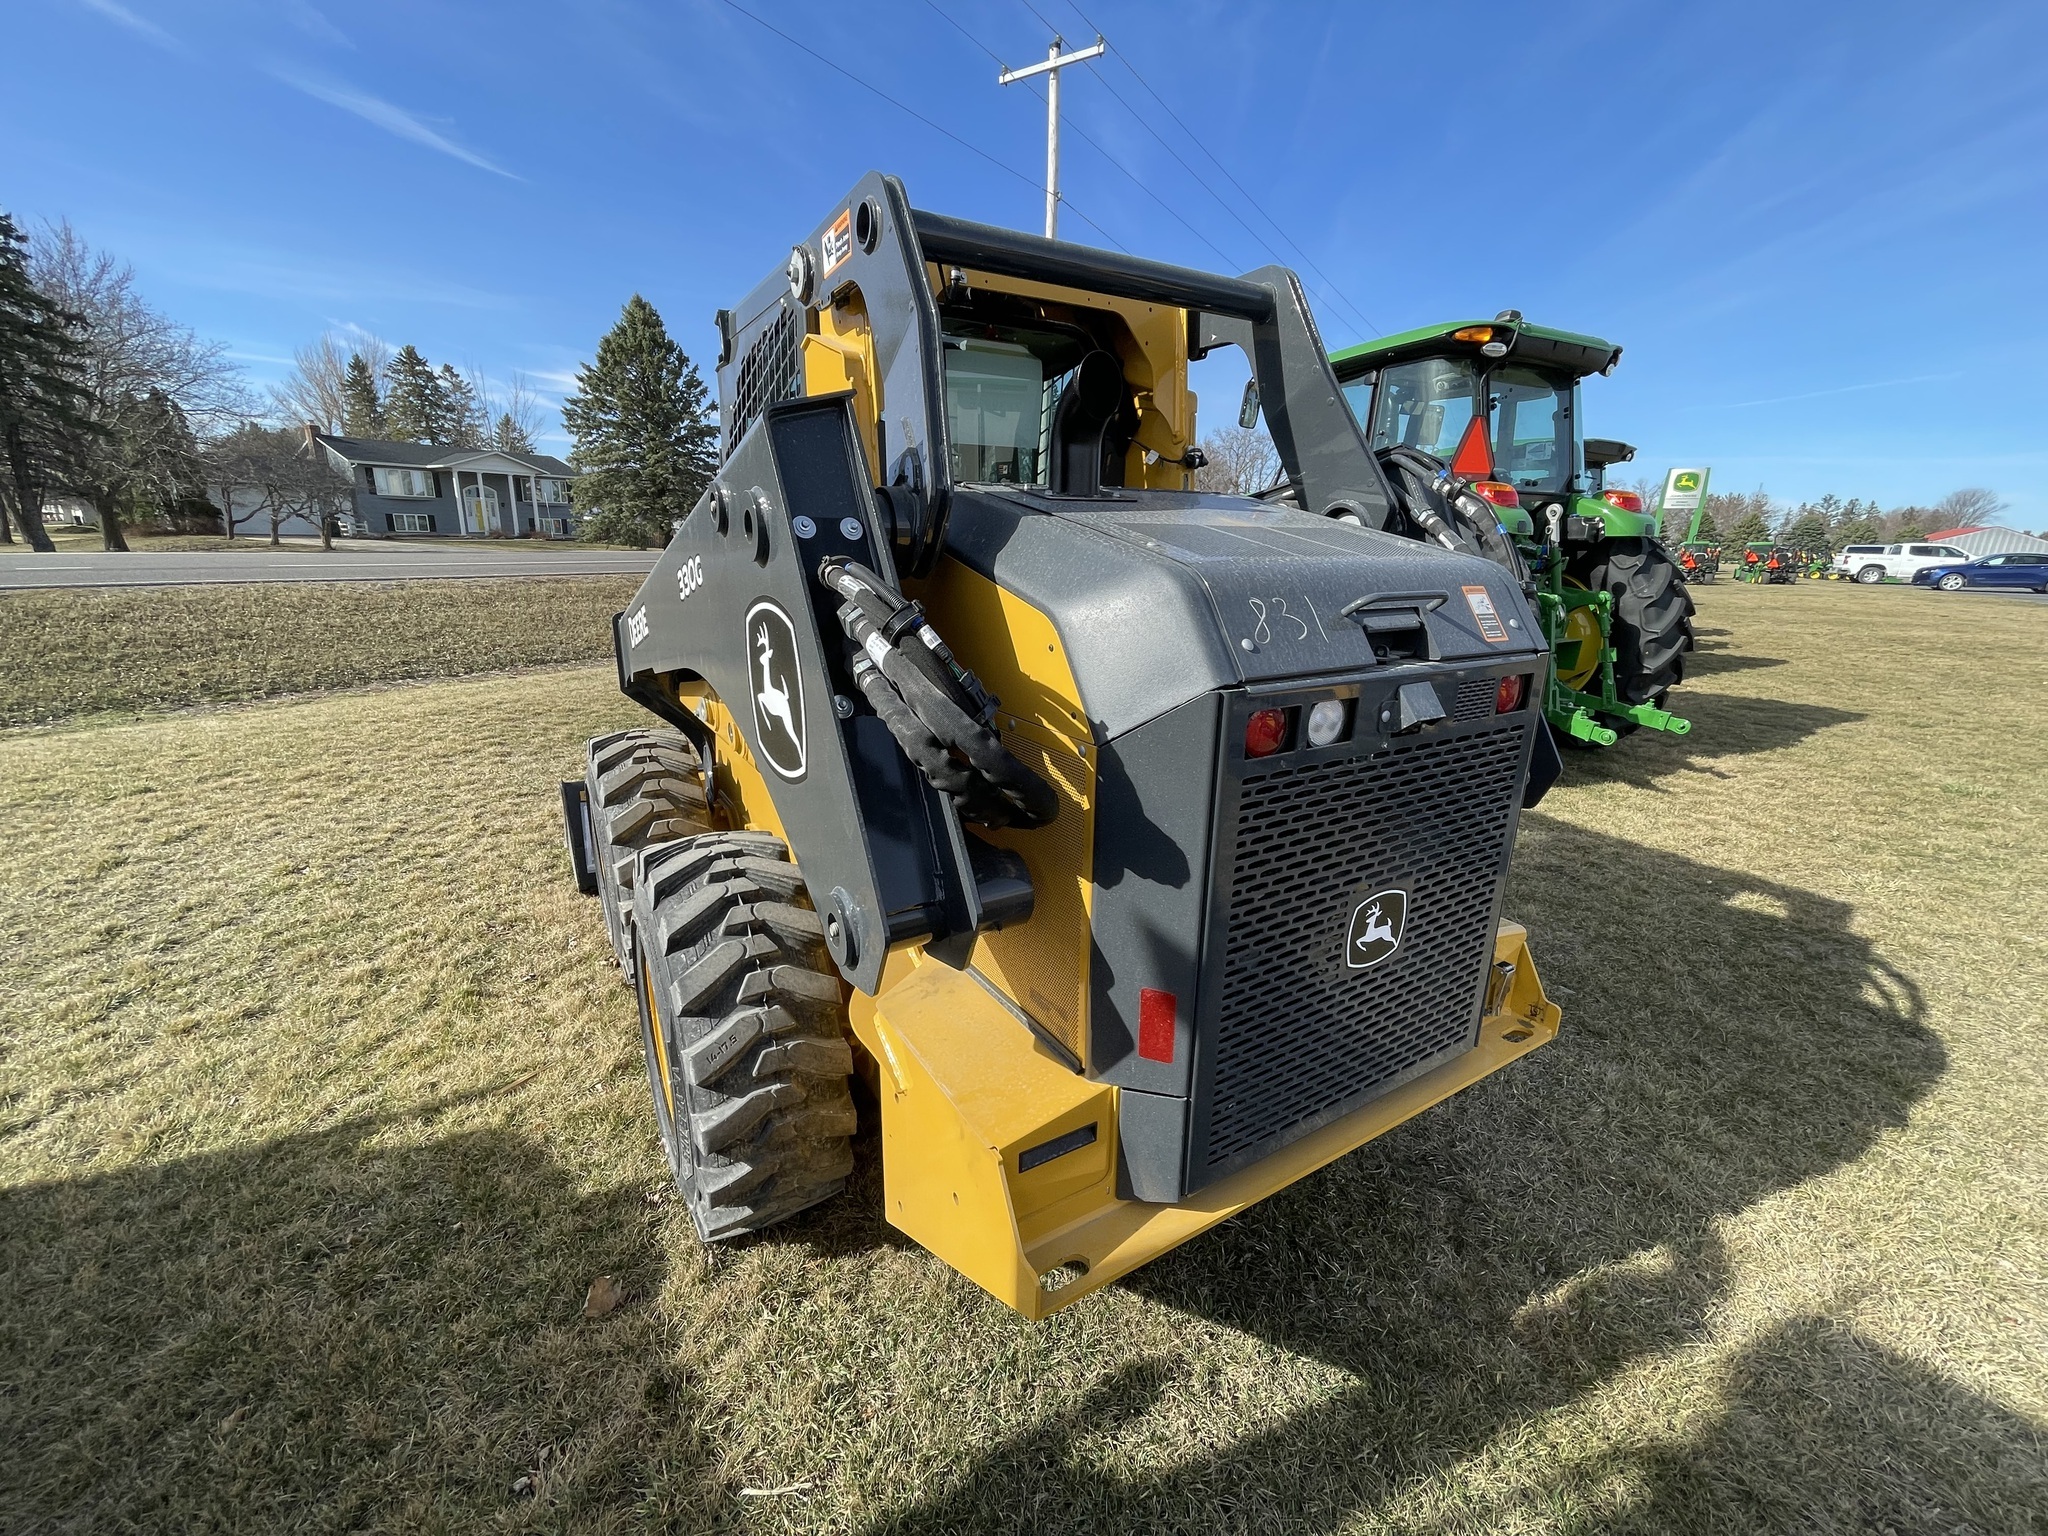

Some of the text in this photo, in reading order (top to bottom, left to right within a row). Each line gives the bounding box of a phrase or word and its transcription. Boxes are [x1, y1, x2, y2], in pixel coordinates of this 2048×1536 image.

[677, 555, 703, 600] 330G
[628, 605, 649, 648] DEERE
[1249, 595, 1330, 644] 831
[706, 1034, 738, 1065] 14-17.5
